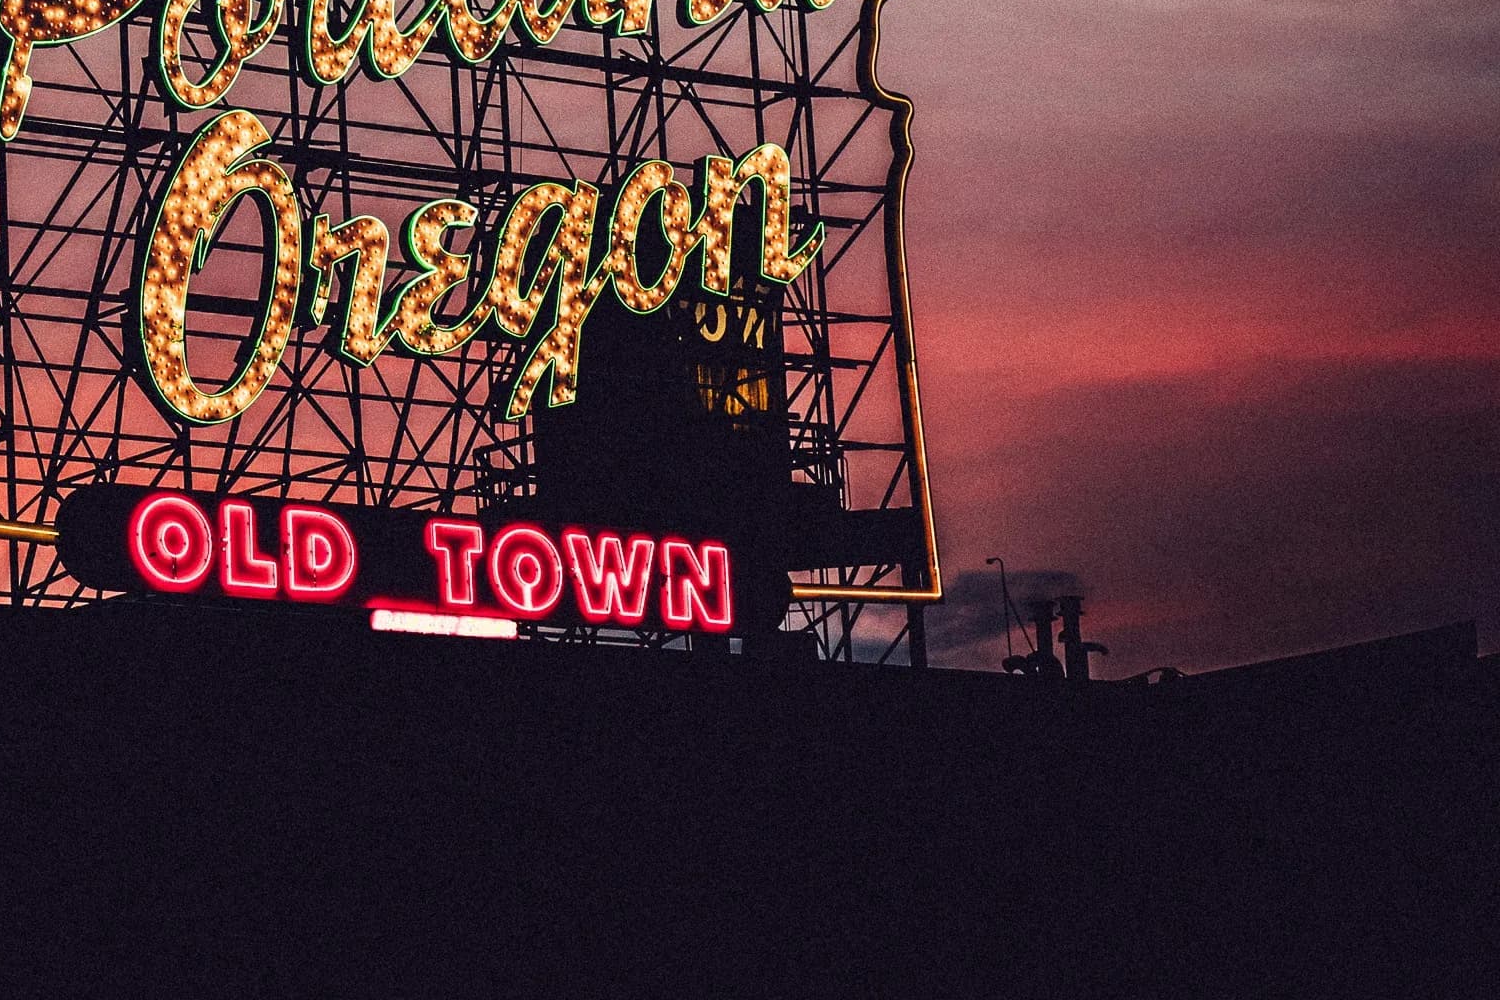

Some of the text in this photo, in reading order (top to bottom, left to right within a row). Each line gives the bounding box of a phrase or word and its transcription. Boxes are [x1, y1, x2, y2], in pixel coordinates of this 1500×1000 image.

[140, 108, 826, 423] Oregon
[133, 493, 733, 626] OLD TOWN
